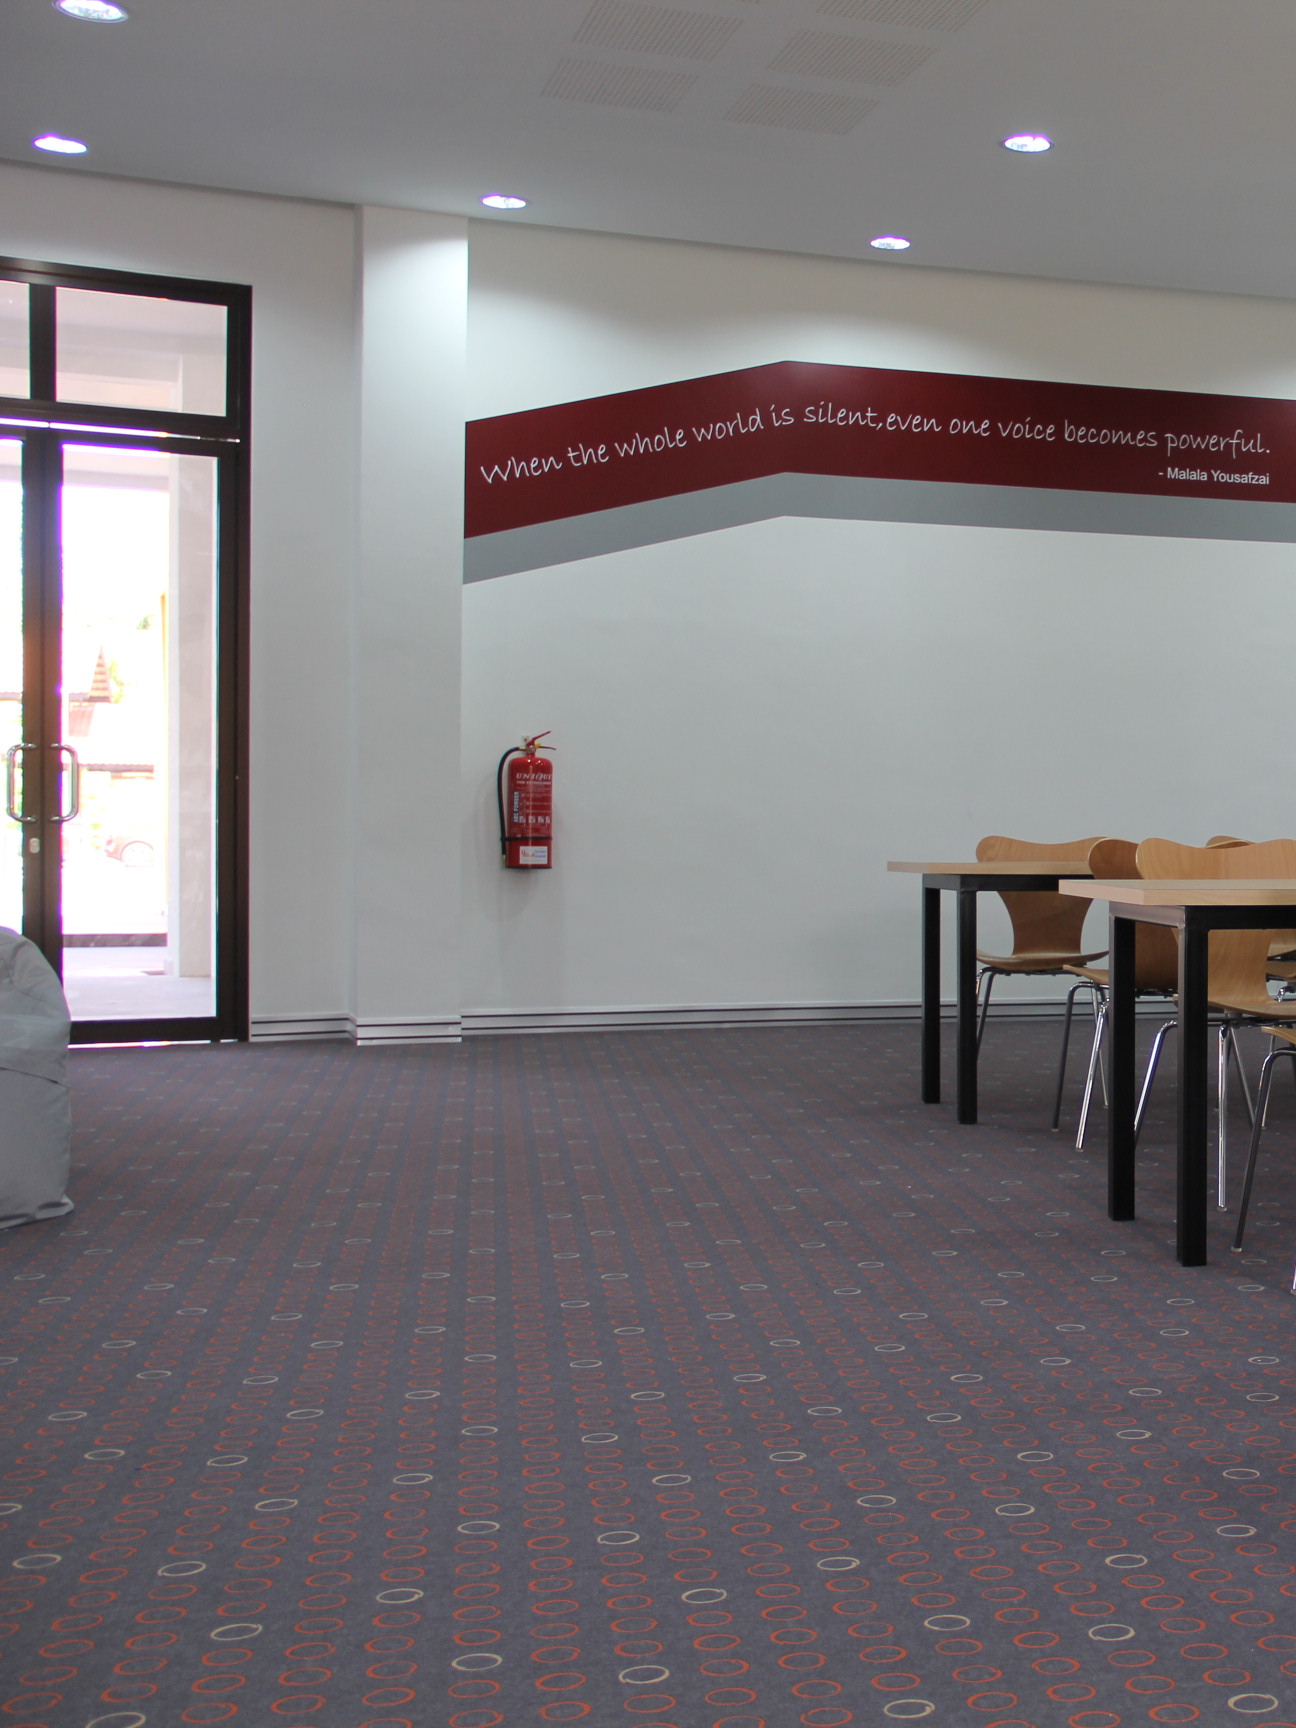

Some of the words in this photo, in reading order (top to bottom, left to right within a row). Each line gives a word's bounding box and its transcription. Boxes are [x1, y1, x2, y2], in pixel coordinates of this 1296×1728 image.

[480, 456, 563, 483] When
[567, 442, 610, 466] the
[614, 427, 687, 457] whole
[692, 408, 764, 440] world
[770, 404, 795, 427] is
[949, 418, 991, 436] one
[998, 417, 1056, 441] voice
[1064, 419, 1159, 447] becomes
[1165, 430, 1271, 458] powerful.
[1167, 467, 1208, 482] Malala
[1211, 469, 1270, 485] Yousafzai
